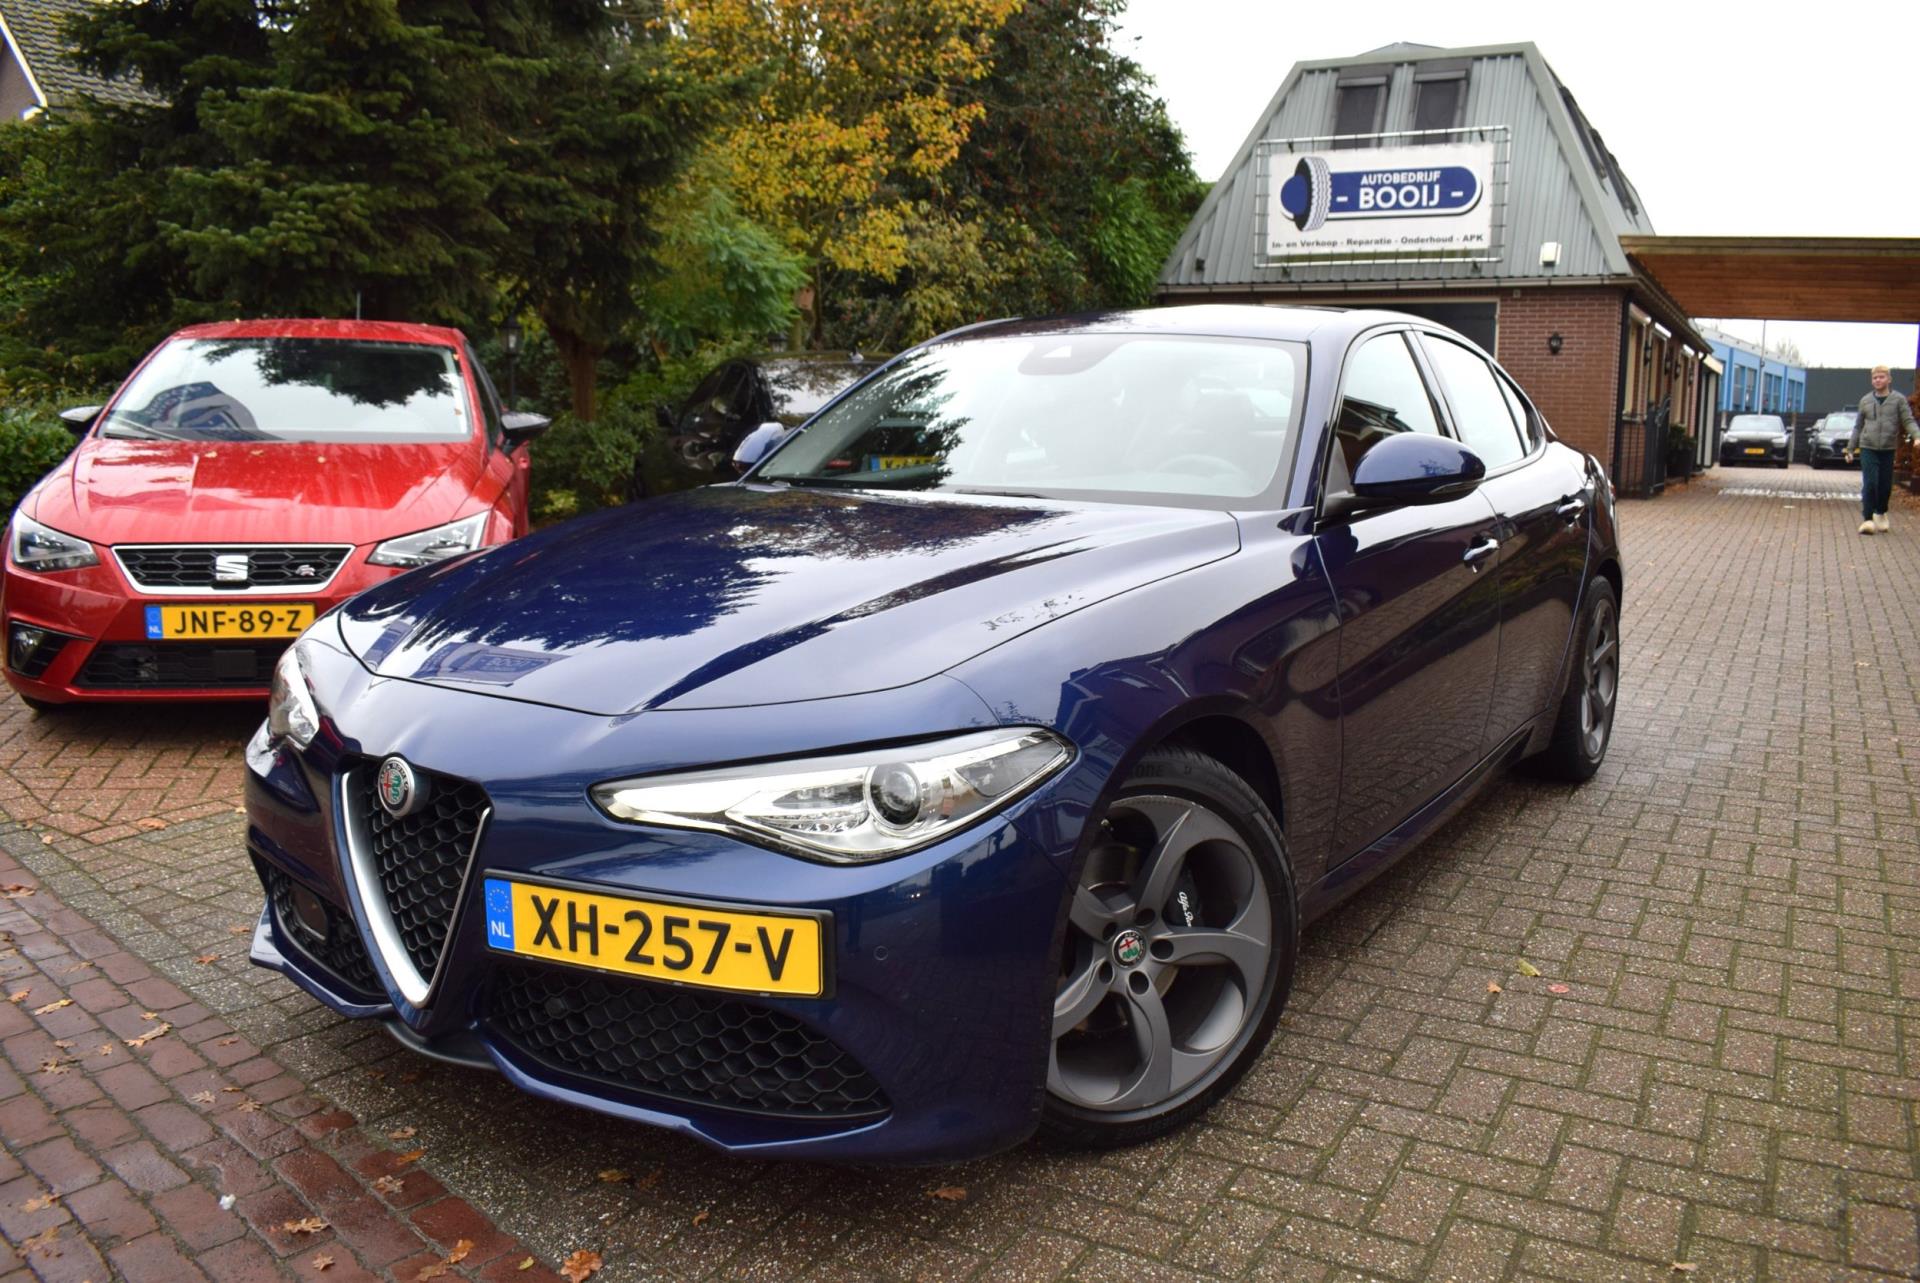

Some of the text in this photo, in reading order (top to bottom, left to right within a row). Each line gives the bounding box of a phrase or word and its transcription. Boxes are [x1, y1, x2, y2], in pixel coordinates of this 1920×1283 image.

[1360, 171, 1441, 185] AUTOBEDRIJF
[1359, 184, 1440, 210] BOOIJ
[1300, 238, 1338, 248] Verkoop
[1346, 237, 1392, 247] Reparatie
[1400, 235, 1454, 245] Onderhoud
[1462, 234, 1484, 243] APK
[149, 626, 161, 634] NL
[174, 610, 302, 634] JNF-89-Z
[491, 920, 511, 938] NL
[530, 895, 795, 982] XH-257-V
